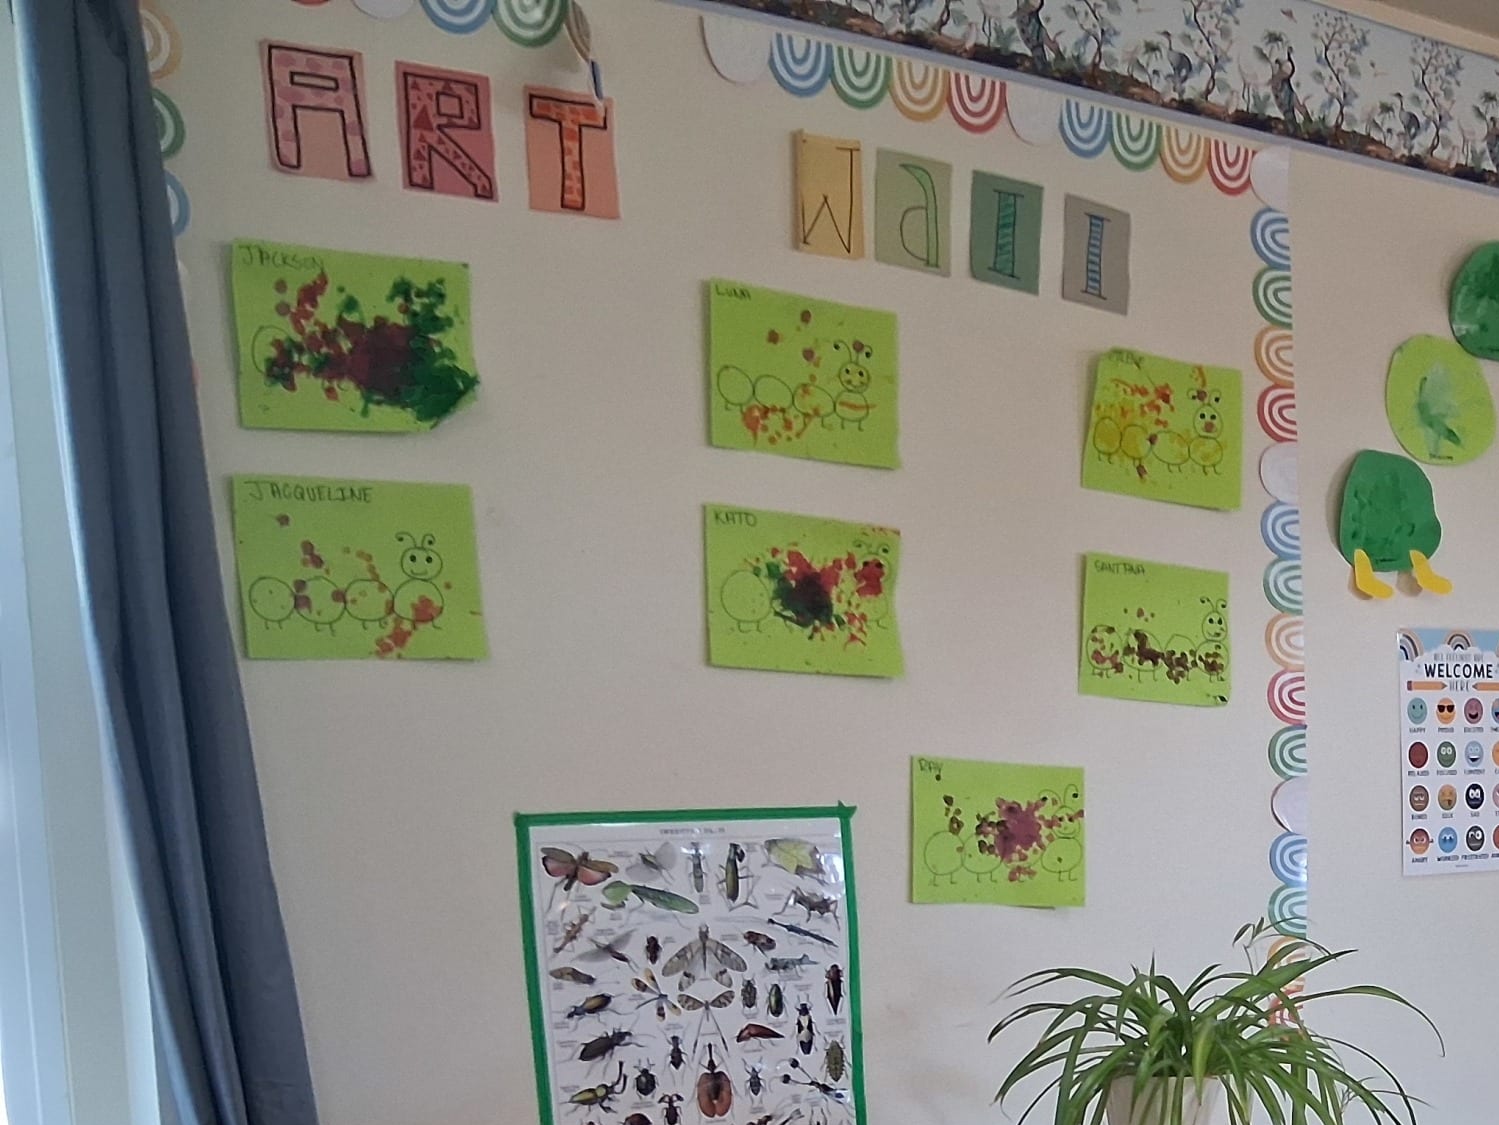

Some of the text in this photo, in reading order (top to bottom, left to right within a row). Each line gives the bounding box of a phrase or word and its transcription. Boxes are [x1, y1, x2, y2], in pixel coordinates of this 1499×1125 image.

[267, 44, 606, 210] ART
[243, 481, 373, 503] JACQUELINE
[713, 510, 758, 527] KATO
[1424, 663, 1494, 679] WELCOME
